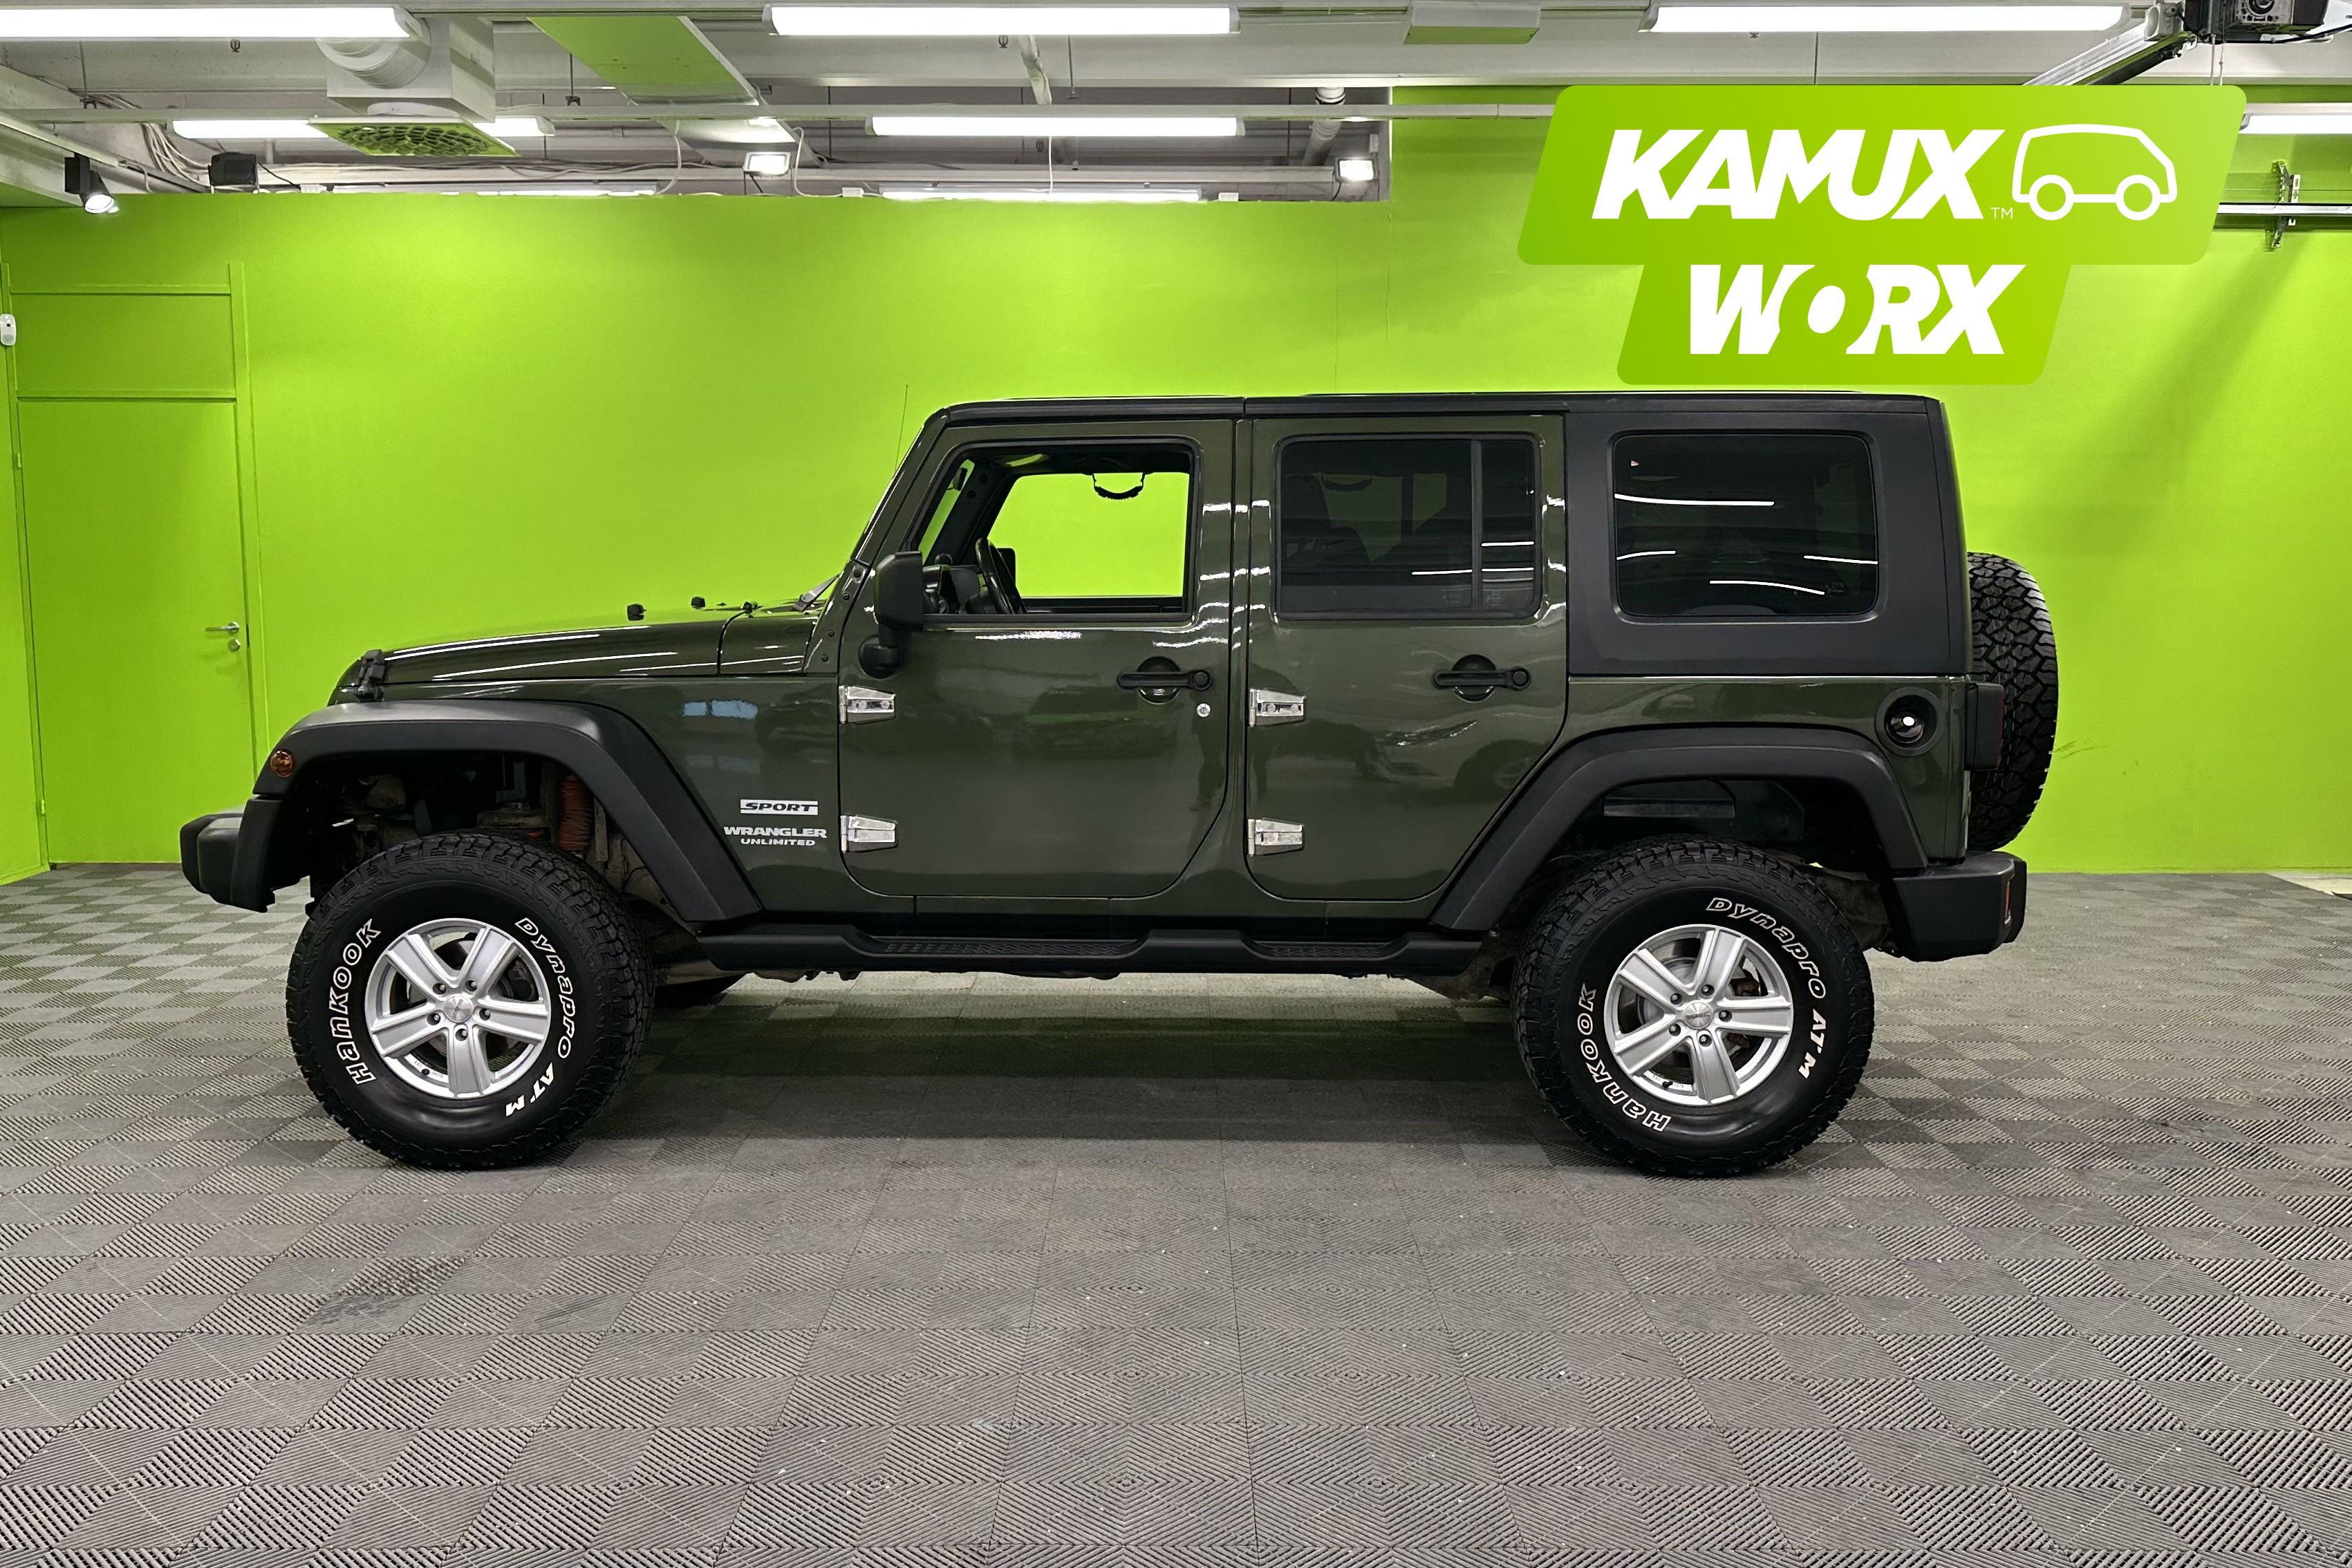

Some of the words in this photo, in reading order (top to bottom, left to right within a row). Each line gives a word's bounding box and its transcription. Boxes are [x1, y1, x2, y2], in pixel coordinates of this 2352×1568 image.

[745, 802, 814, 812] SPORT
[723, 826, 828, 839] WRANGLER
[740, 838, 816, 846] UNLIMITED
